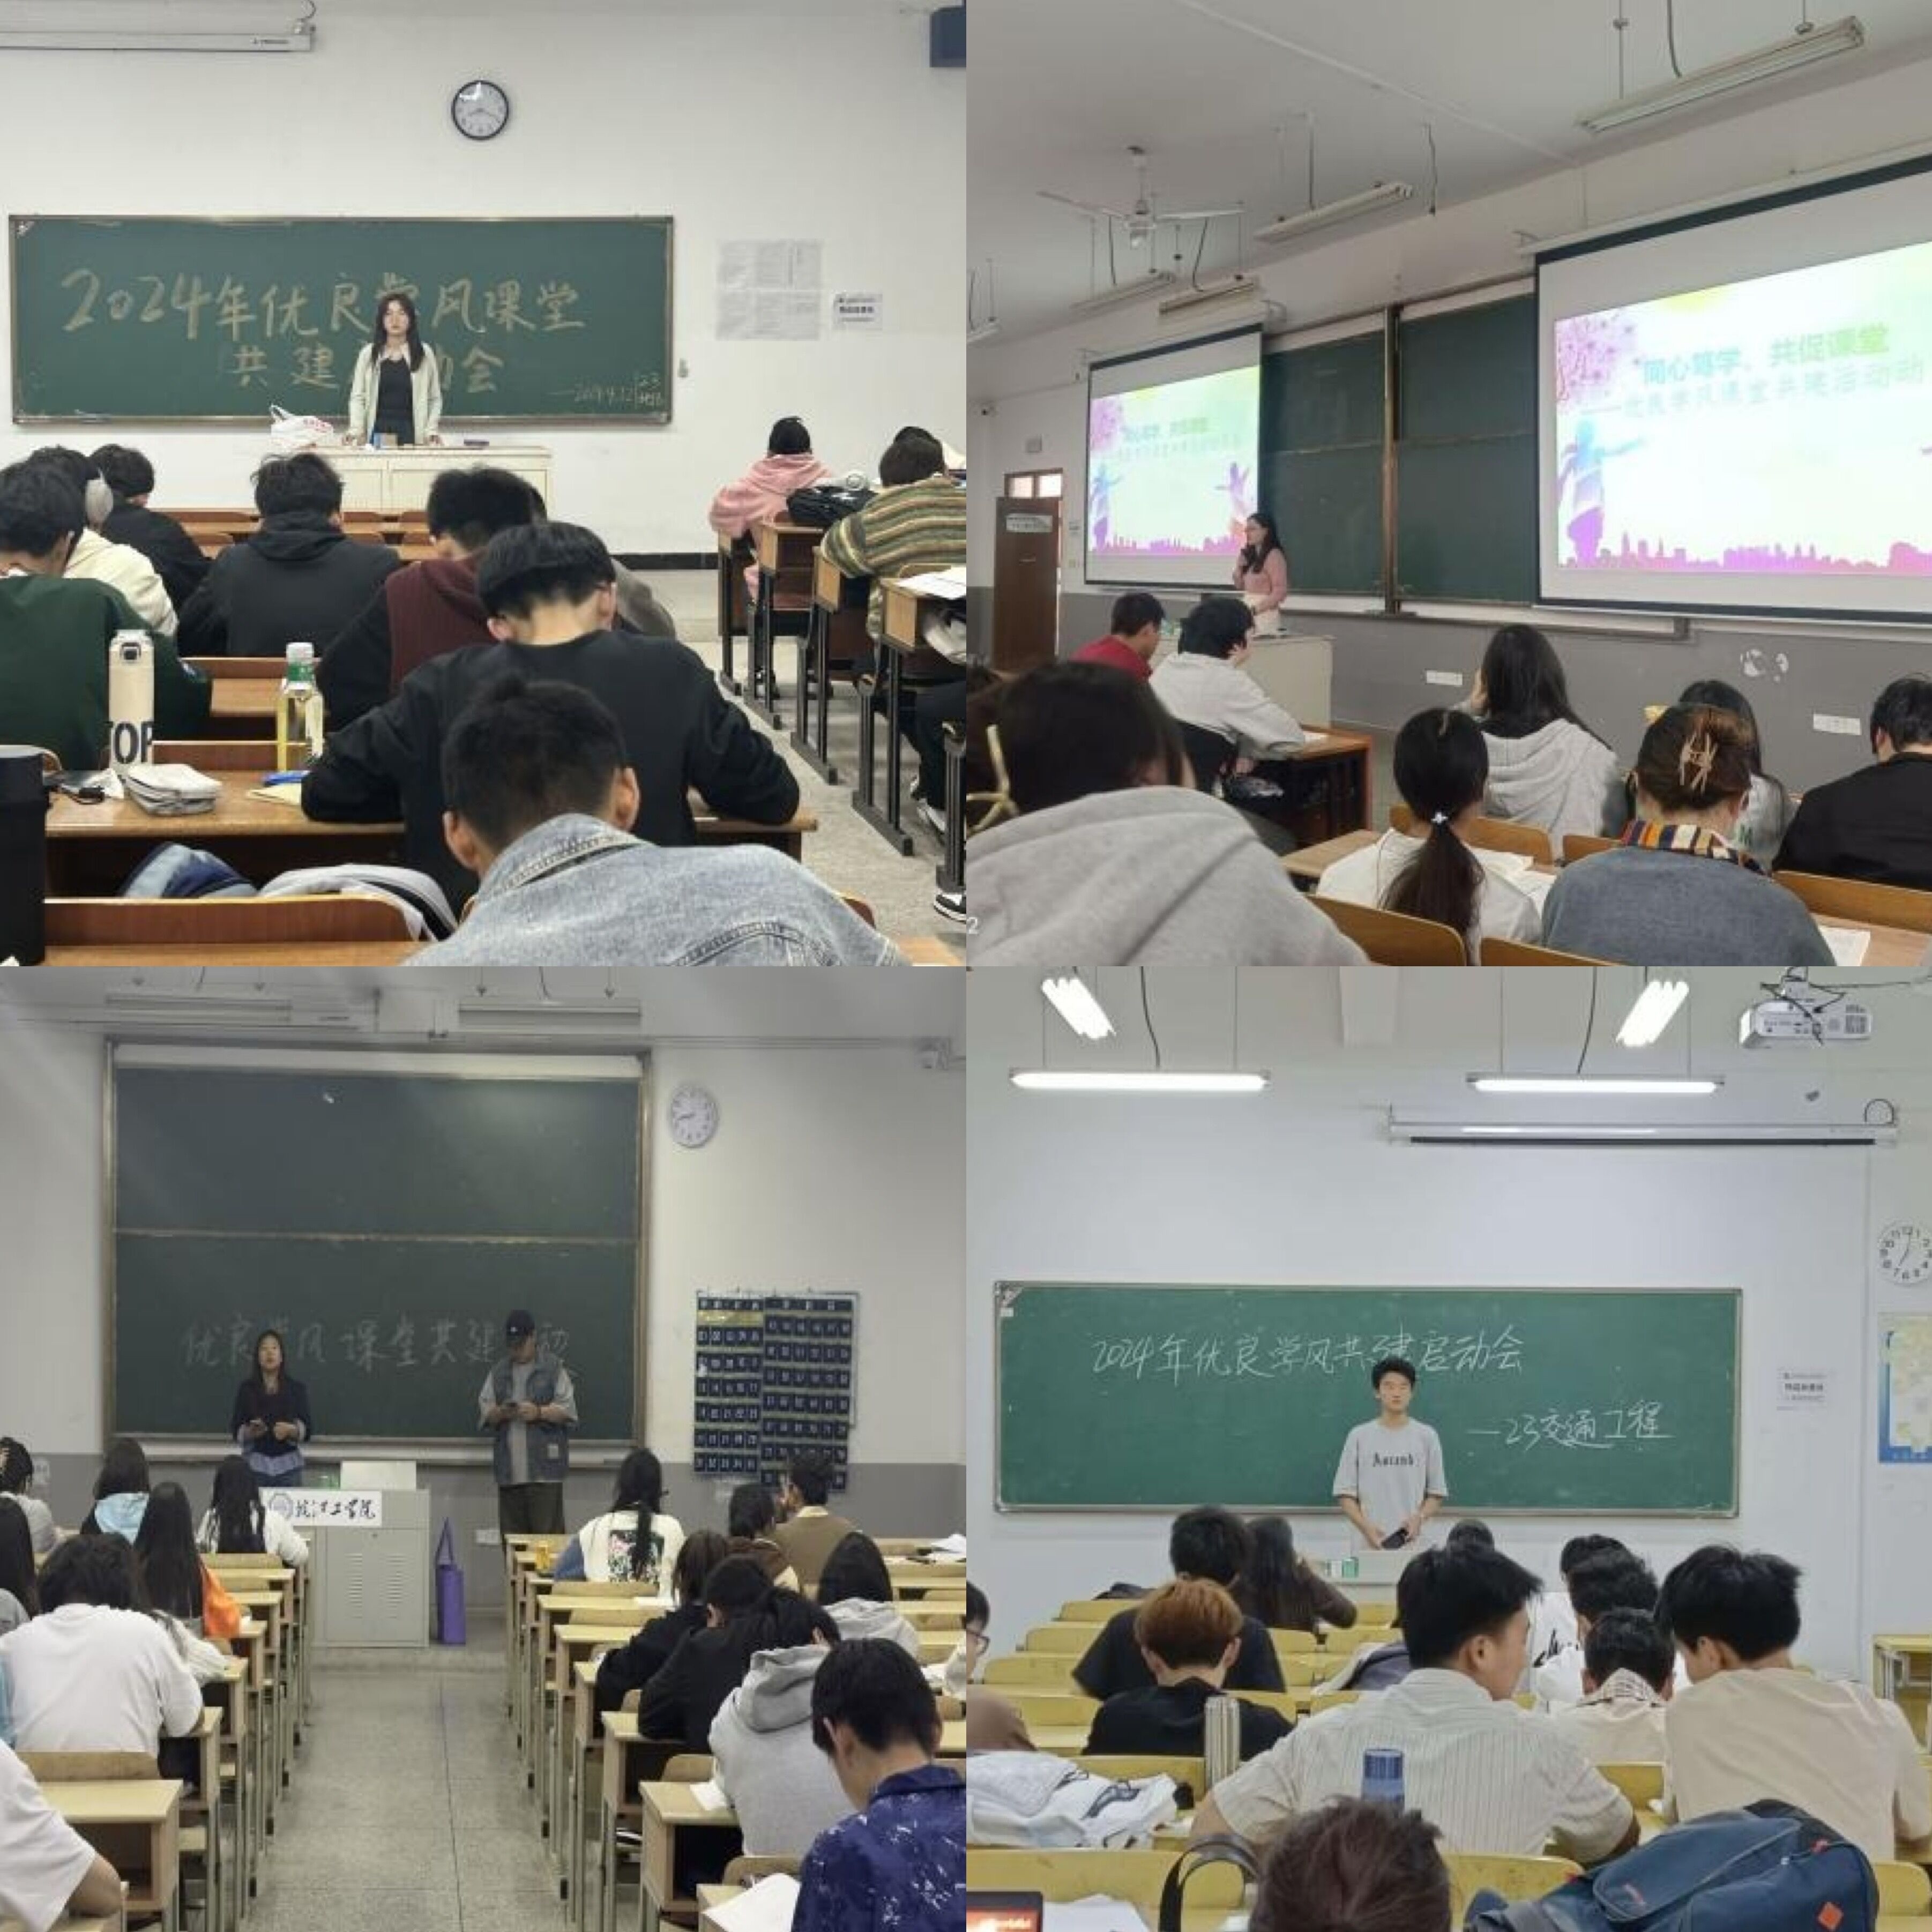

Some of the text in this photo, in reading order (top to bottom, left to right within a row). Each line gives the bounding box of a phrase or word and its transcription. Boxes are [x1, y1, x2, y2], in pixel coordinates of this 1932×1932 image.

[225, 343, 505, 394] 共建会
[1091, 1324, 1524, 1388] 2024年优良学风共建启动会
